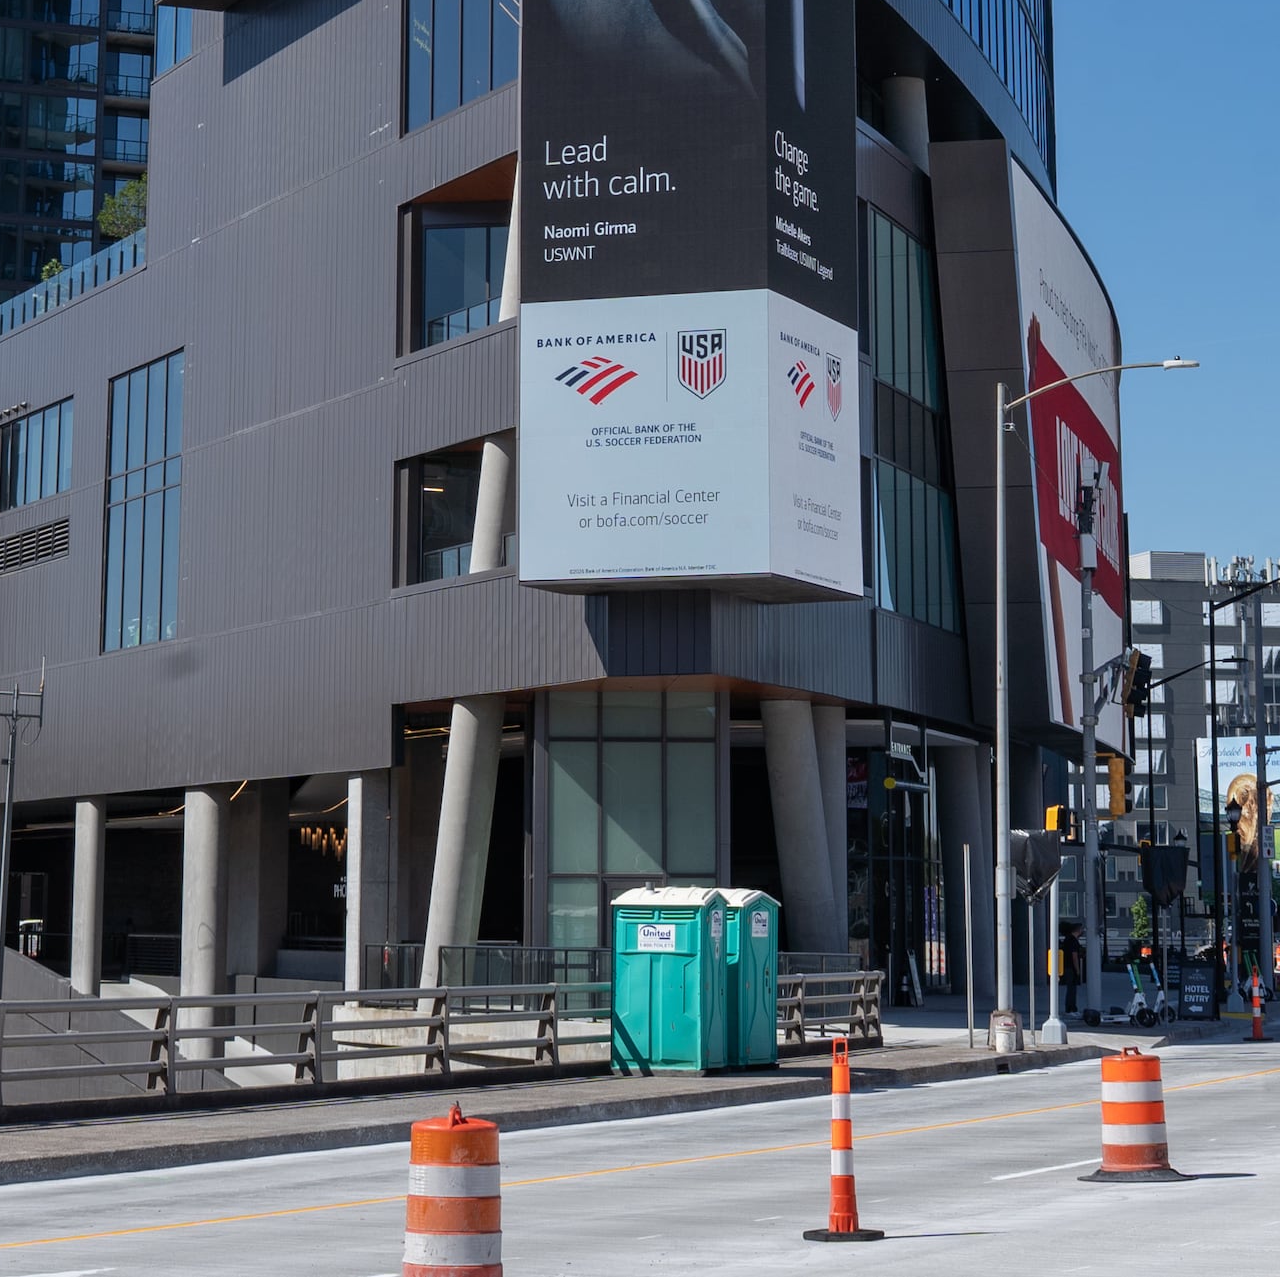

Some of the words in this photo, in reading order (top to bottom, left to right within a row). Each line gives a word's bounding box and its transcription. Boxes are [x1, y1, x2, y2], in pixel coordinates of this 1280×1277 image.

[544, 135, 608, 167] Lead
[774, 130, 809, 176] Change
[543, 170, 599, 200] with
[608, 167, 677, 197] calm.
[775, 165, 791, 196] the
[792, 180, 820, 213] game.
[544, 222, 590, 240] Naomi
[594, 220, 637, 237] Girma
[544, 245, 596, 263] USWNT
[537, 337, 573, 348] BANK
[576, 336, 593, 345] OF
[596, 332, 657, 345] AMERICA
[682, 333, 723, 360] USA
[780, 331, 793, 345] BANK
[591, 426, 632, 436] OFFICIAL
[635, 425, 660, 434] BANK
[663, 424, 675, 433] OF
[678, 423, 696, 432] THE
[586, 439, 602, 448] U.S.
[605, 437, 641, 447] SOCCER
[644, 434, 702, 445] FEDERATION
[567, 493, 596, 508] Visit
[600, 496, 608, 506] a
[612, 490, 670, 506] Financial
[675, 489, 720, 503] Center
[579, 517, 592, 529] or
[596, 512, 709, 528] bofa.com/soccer
[642, 927, 671, 938] United
[1184, 985, 1210, 993] HOTEL
[1184, 994, 1210, 1003] ENTRY
